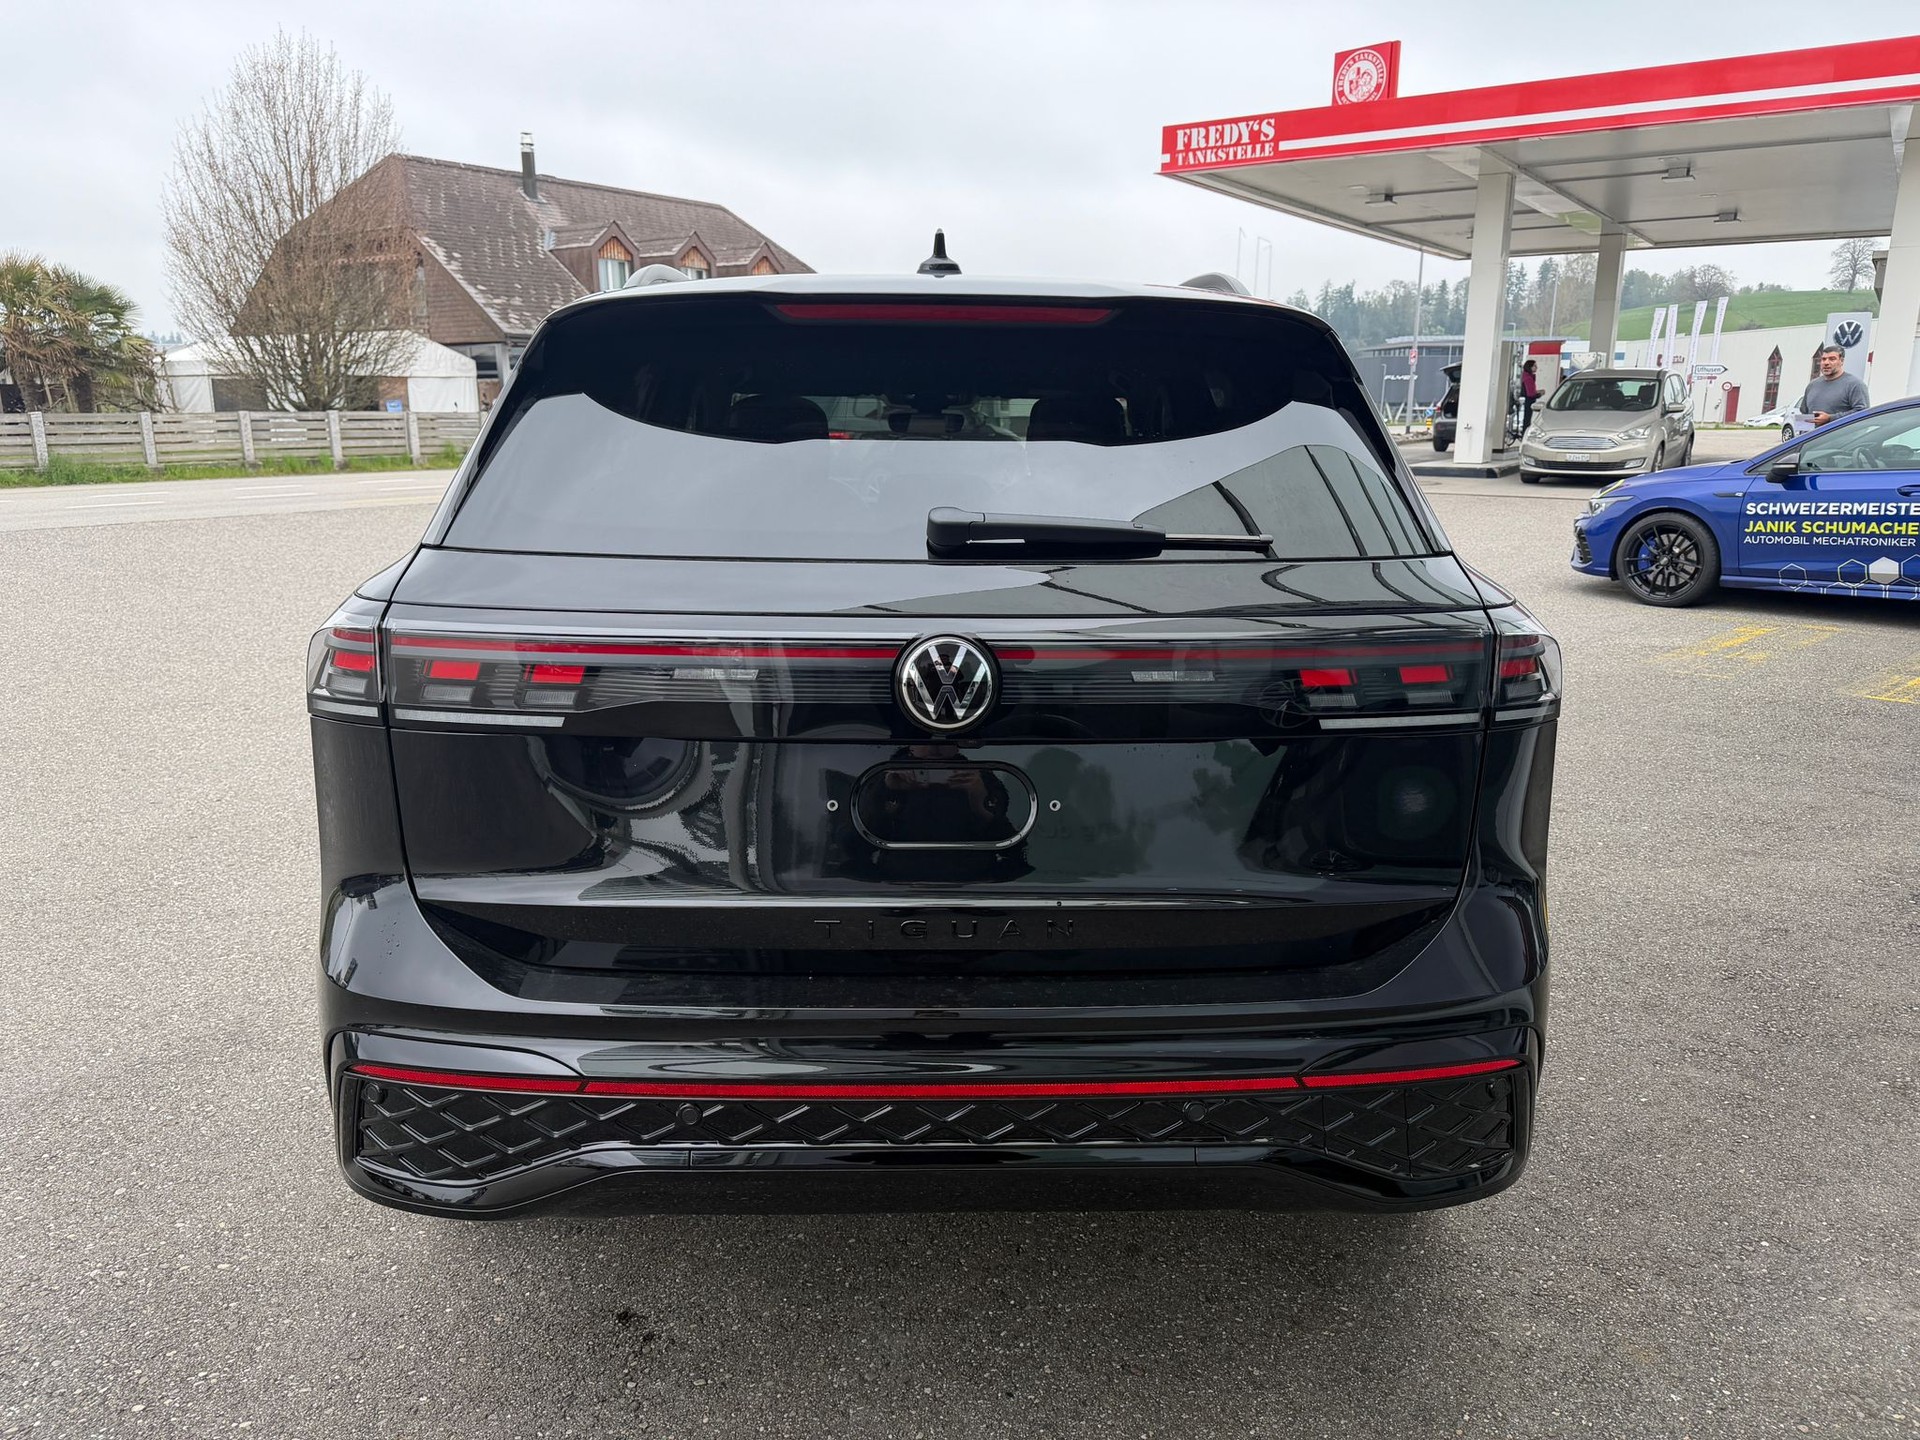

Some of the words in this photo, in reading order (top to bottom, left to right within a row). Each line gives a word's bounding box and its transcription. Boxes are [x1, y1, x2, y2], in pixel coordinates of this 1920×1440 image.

[1175, 142, 1274, 166] TANKSTELLE
[1745, 502, 1920, 516] SCHWEIZERMEISTE
[1744, 520, 1797, 534] JANIK
[1801, 521, 1920, 535] SCHUMACHE
[1743, 535, 1810, 545] AUTOMOBIL
[1813, 536, 1917, 547] MECHATRONIKER
[814, 919, 1074, 940] TIGUAN
